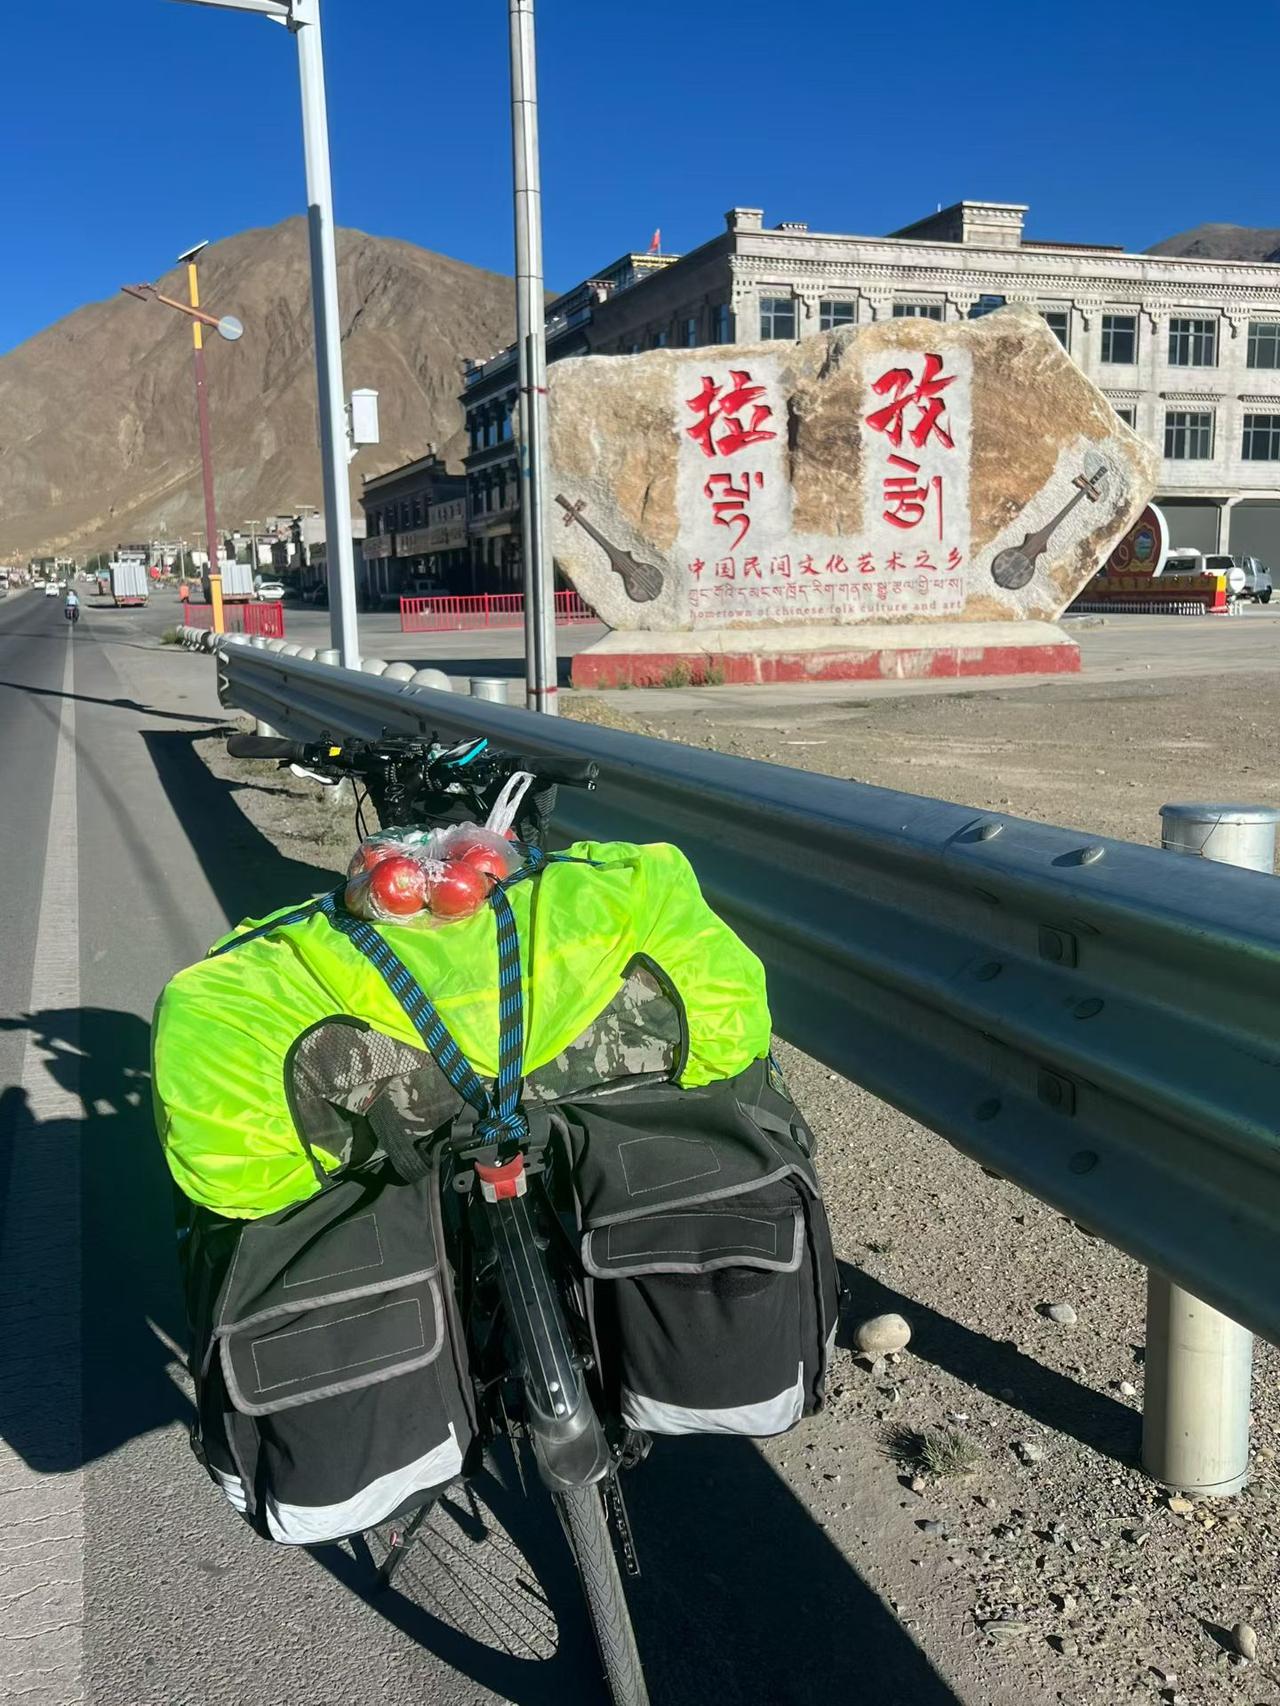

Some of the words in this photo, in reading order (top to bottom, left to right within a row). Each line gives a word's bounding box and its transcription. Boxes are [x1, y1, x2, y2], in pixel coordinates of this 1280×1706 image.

[687, 547, 963, 582] 中国民间文化艺术之乡
[689, 607, 752, 620] hometown
[757, 606, 769, 617] of
[775, 605, 825, 617] chinese
[830, 603, 855, 614] folk
[860, 602, 908, 613] culture
[913, 600, 937, 611] and
[943, 600, 962, 610] art
